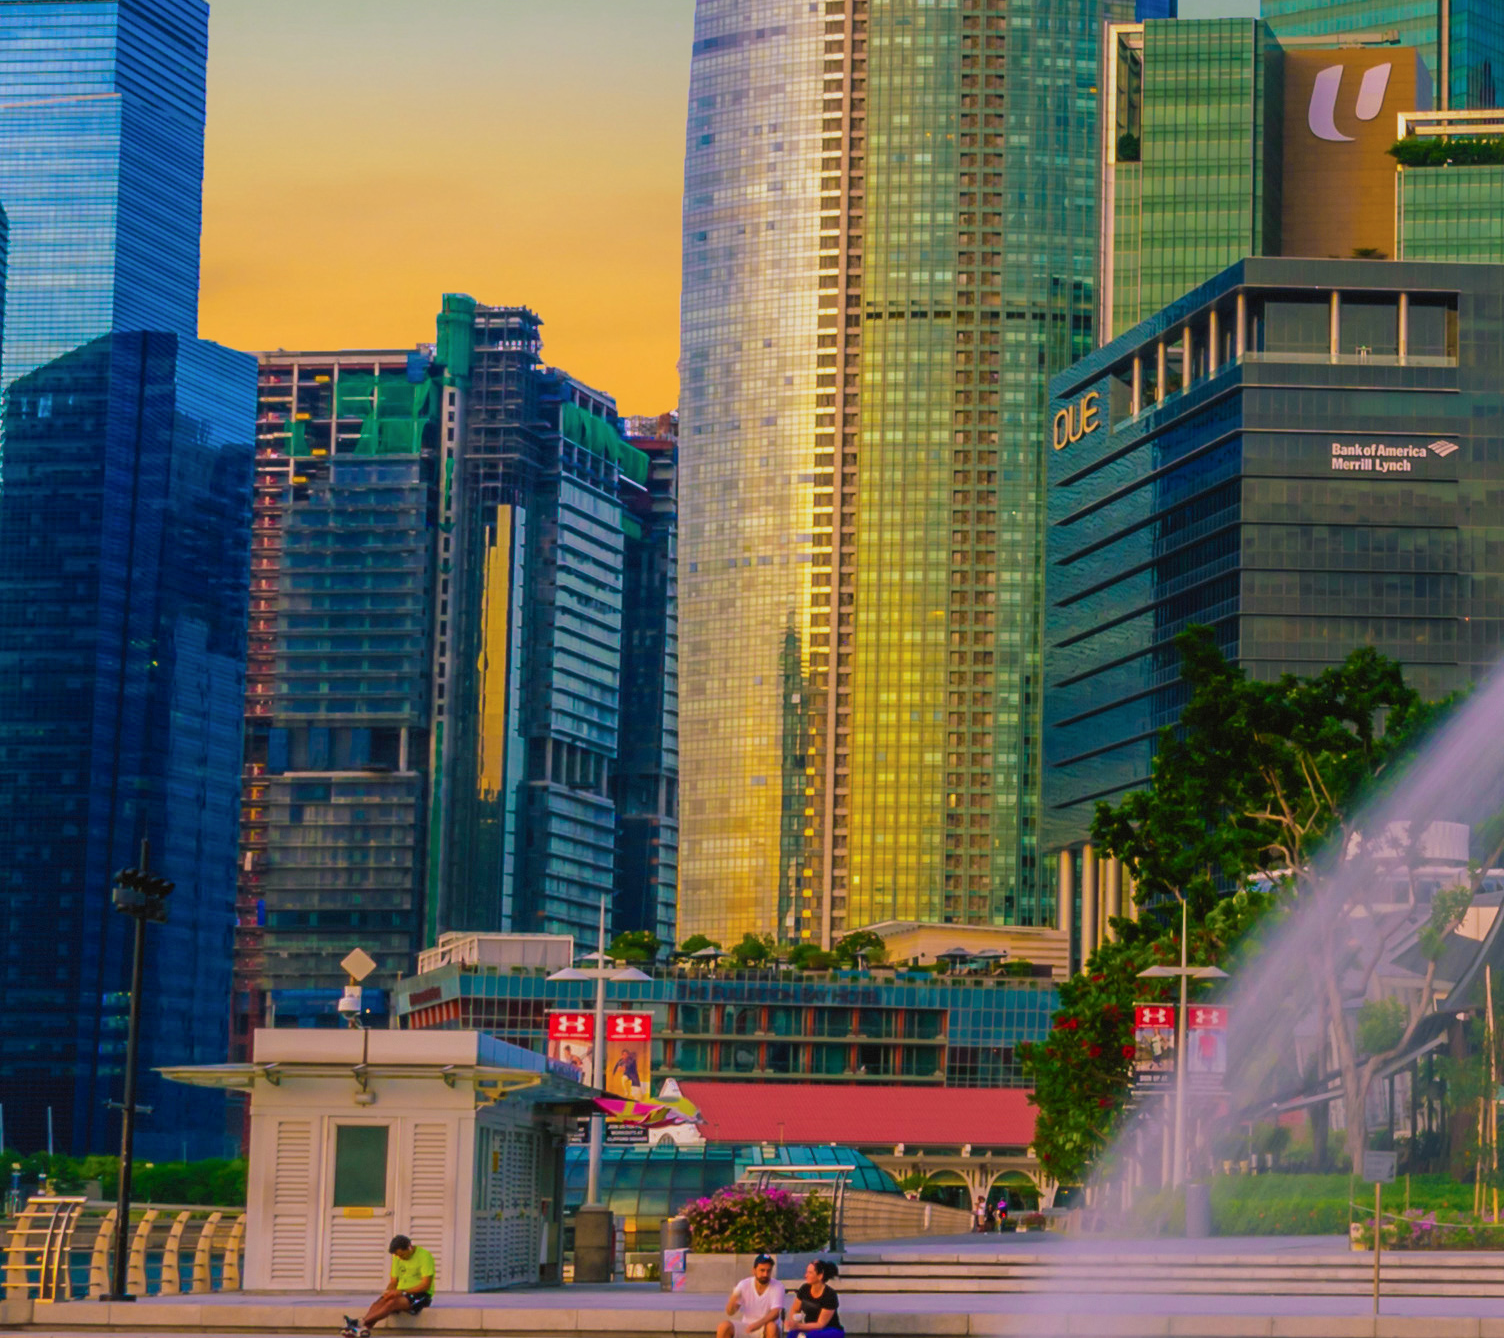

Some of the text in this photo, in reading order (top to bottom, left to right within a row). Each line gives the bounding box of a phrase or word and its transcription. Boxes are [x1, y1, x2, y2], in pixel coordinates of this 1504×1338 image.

[1053, 391, 1100, 451] OUE
[1332, 443, 1427, 458] Bank of America
[1332, 458, 1411, 473] Merrill Lynch
